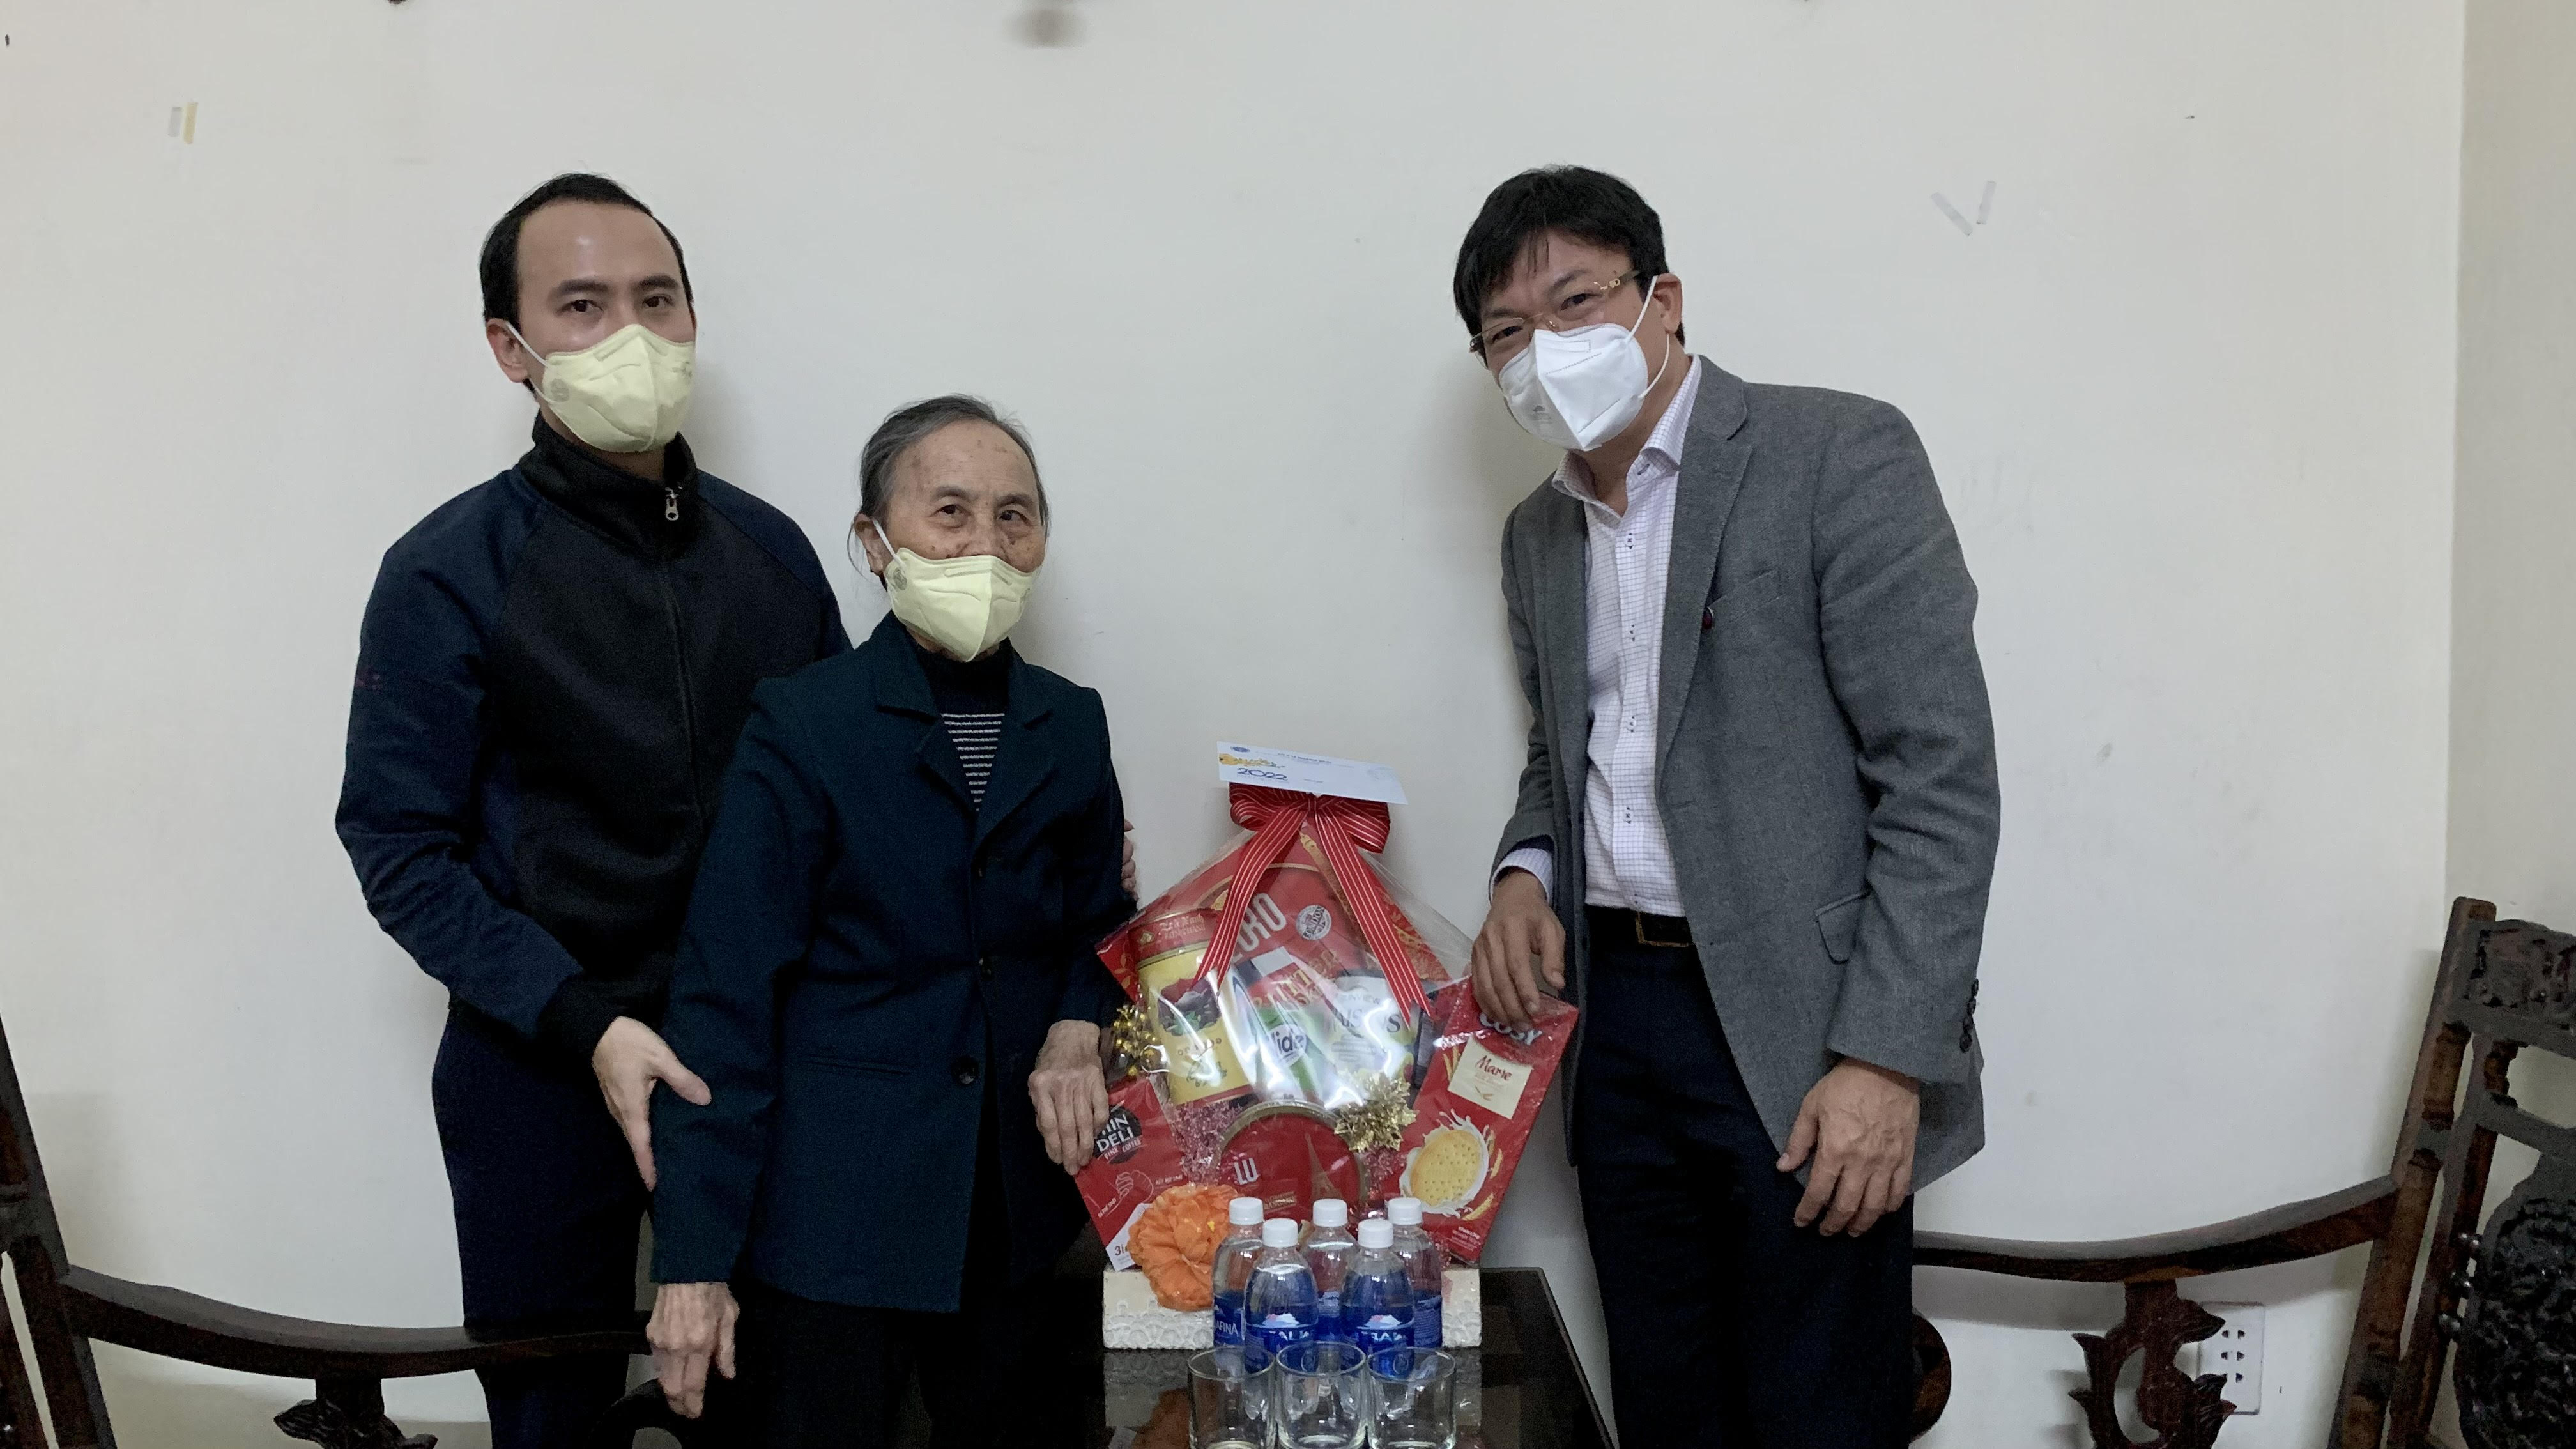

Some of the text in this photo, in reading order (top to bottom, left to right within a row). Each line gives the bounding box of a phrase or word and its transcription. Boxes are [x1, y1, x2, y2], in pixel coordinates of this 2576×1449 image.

[1237, 767, 1287, 781] 2022
[1475, 1055, 1513, 1081] Marie
[1096, 1126, 1134, 1152] DELI
[1103, 1137, 1142, 1160] FINE COFFEE
[1233, 1157, 1259, 1185] LU
